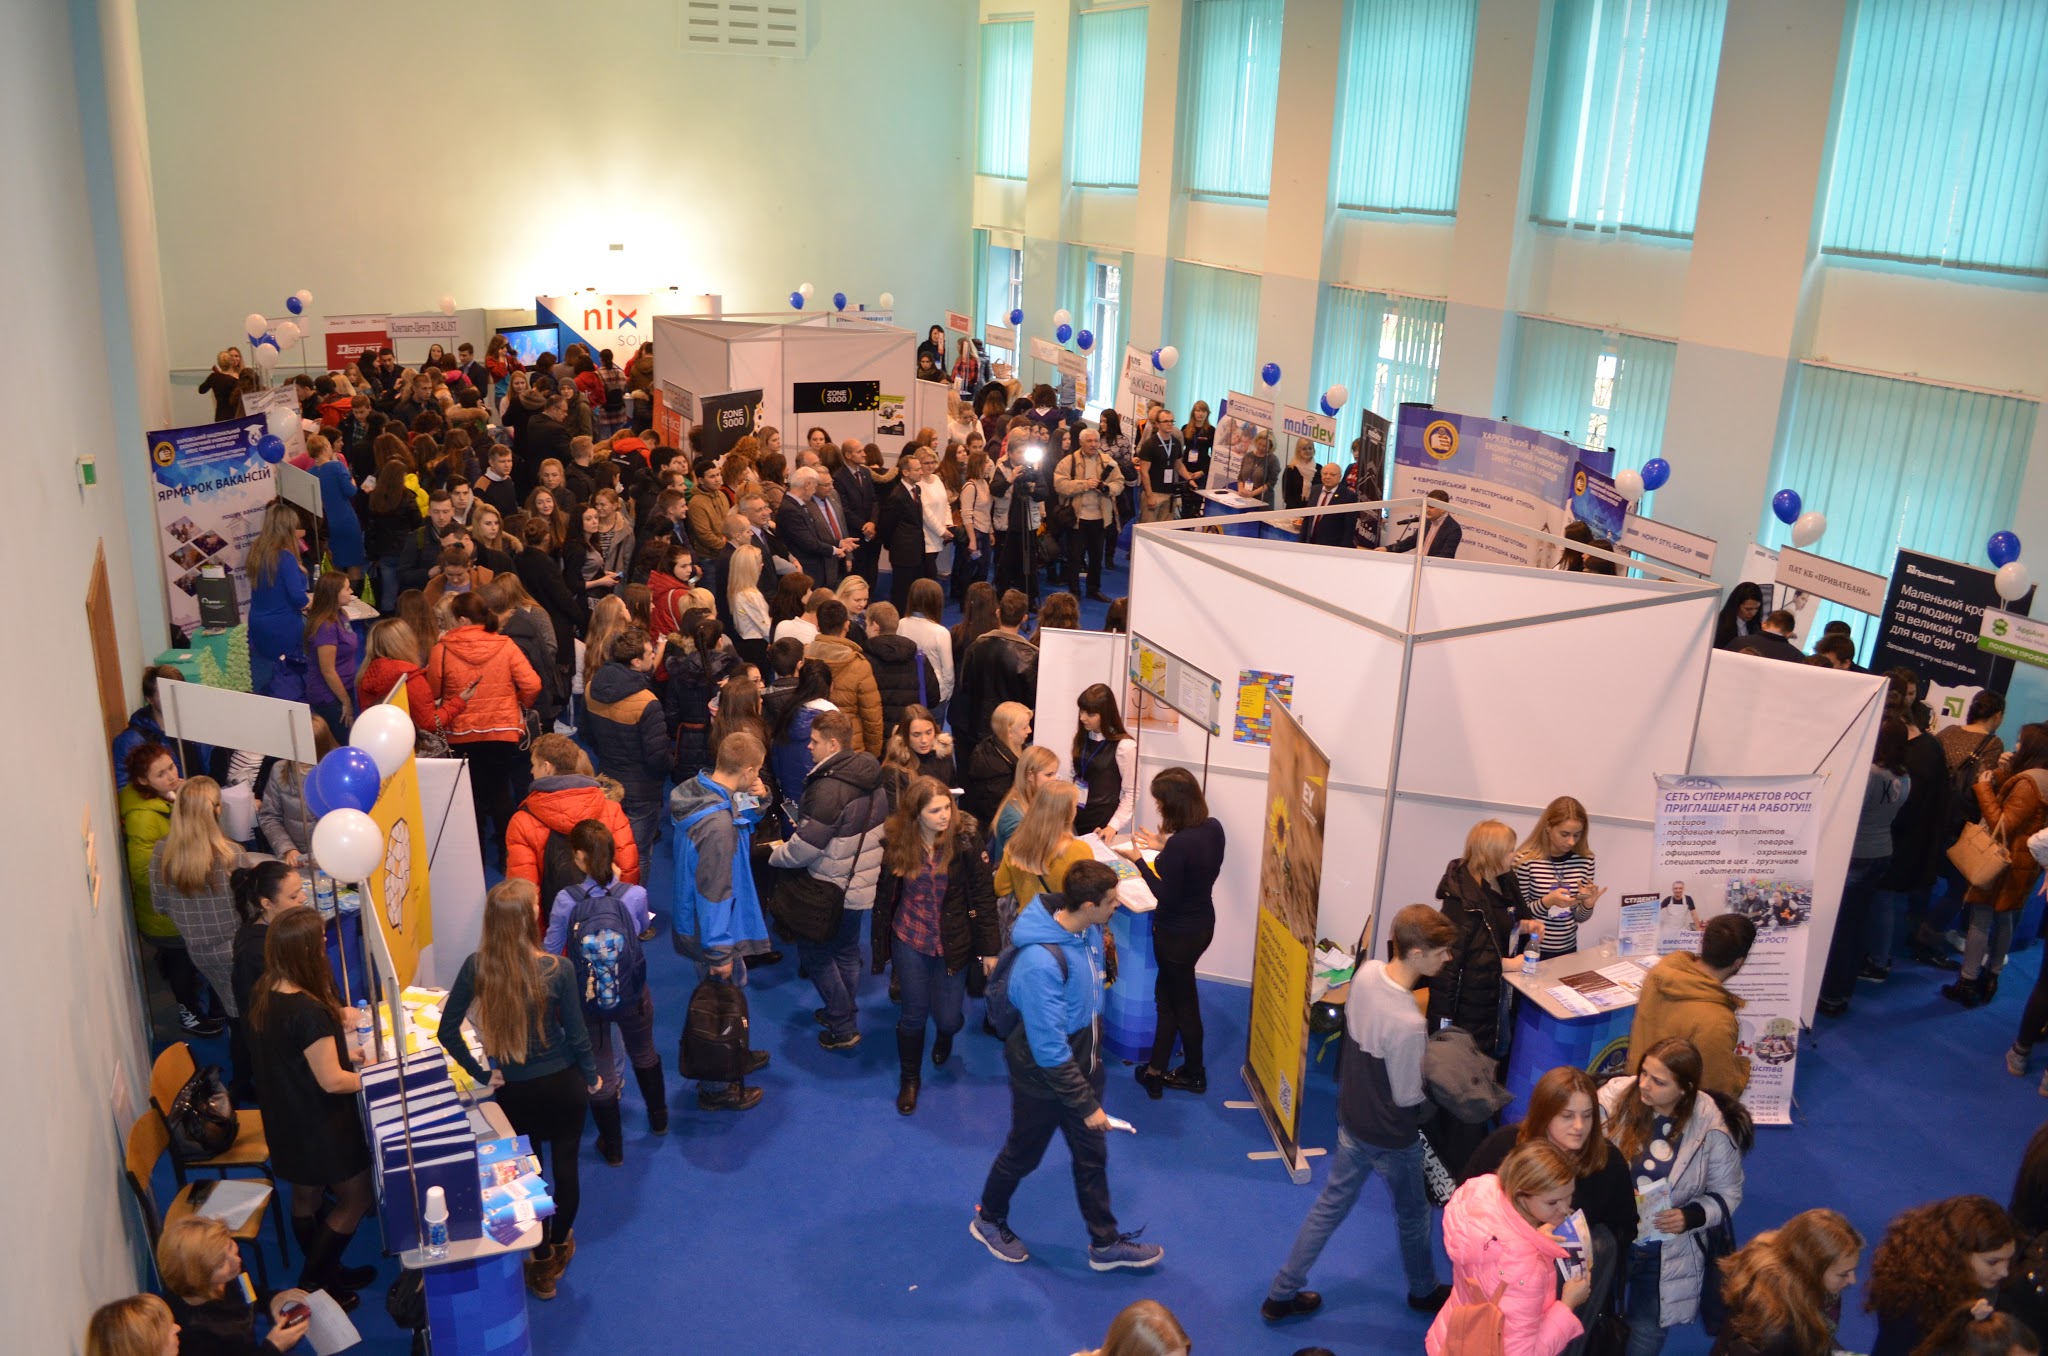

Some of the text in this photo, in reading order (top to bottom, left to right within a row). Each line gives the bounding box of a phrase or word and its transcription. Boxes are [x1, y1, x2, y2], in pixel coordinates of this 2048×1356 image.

[584, 300, 637, 330] nix
[432, 321, 457, 332] DEALIST
[1132, 376, 1164, 396] AKVELON
[722, 408, 744, 419] ZONE
[722, 418, 744, 428] 3000
[1284, 416, 1335, 443] mobidev
[158, 466, 271, 502] ЯРМАРОК ВАКАНСІЙ
[1659, 538, 1672, 548] STYL
[1673, 542, 1692, 554] GROUP
[1788, 564, 1871, 597] ПАТ КБ «ПРИВАТБАНК»
[1901, 584, 1985, 617] Маленький кро
[1896, 600, 1963, 625] для людини
[1889, 624, 1956, 651] для кар'єри
[1894, 612, 1980, 644] та великий стри
[1958, 664, 1976, 675] pb.ua
[1302, 781, 1315, 807] EY
[1665, 792, 1812, 801] СЕТЬ СУПЕРМАРКЕТОВ РОСТ
[1664, 804, 1812, 813] ПРИГЛАШАЕТ НА РАБОТУ!!!
[1700, 867, 1747, 876] водителей
